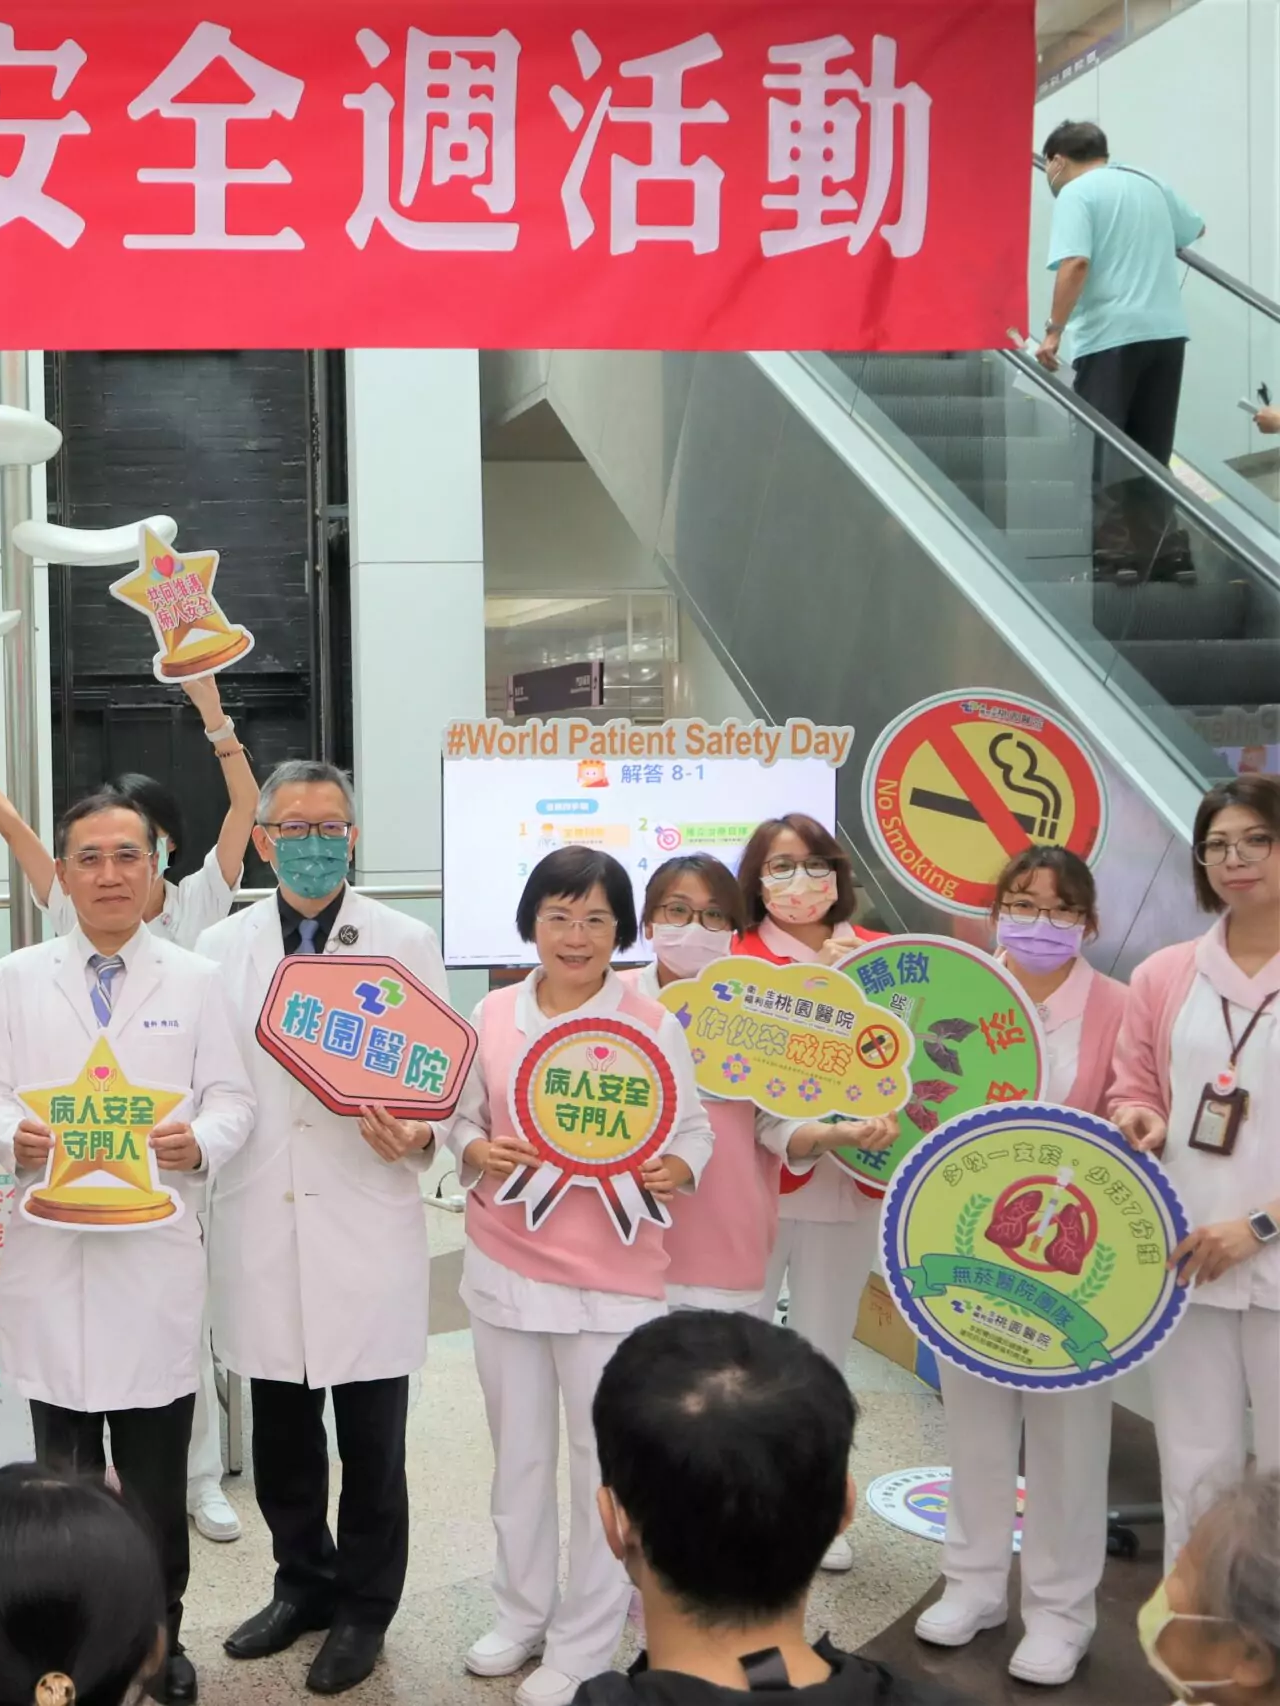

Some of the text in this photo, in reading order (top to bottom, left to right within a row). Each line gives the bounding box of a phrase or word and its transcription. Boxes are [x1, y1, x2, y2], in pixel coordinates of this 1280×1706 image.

[147, 572, 204, 608] 共同維護
[157, 595, 215, 630] 病人安全
[447, 723, 850, 764] #World Patient Safety Day
[621, 764, 705, 784] 解答 8-1
[638, 818, 648, 831] 2
[878, 778, 960, 899] No Smoking
[518, 863, 527, 877] 3
[638, 857, 648, 871] 4
[856, 952, 930, 996] 驕傲
[775, 993, 855, 1030] 桃園醫院
[280, 991, 451, 1097] 桃園醫院
[545, 1067, 651, 1108] 病人安全
[50, 1094, 155, 1126] 病人安全
[555, 1103, 631, 1140] 守門人
[62, 1129, 141, 1161] 守門人
[952, 1265, 1075, 1329] 無菸醫院團隊
